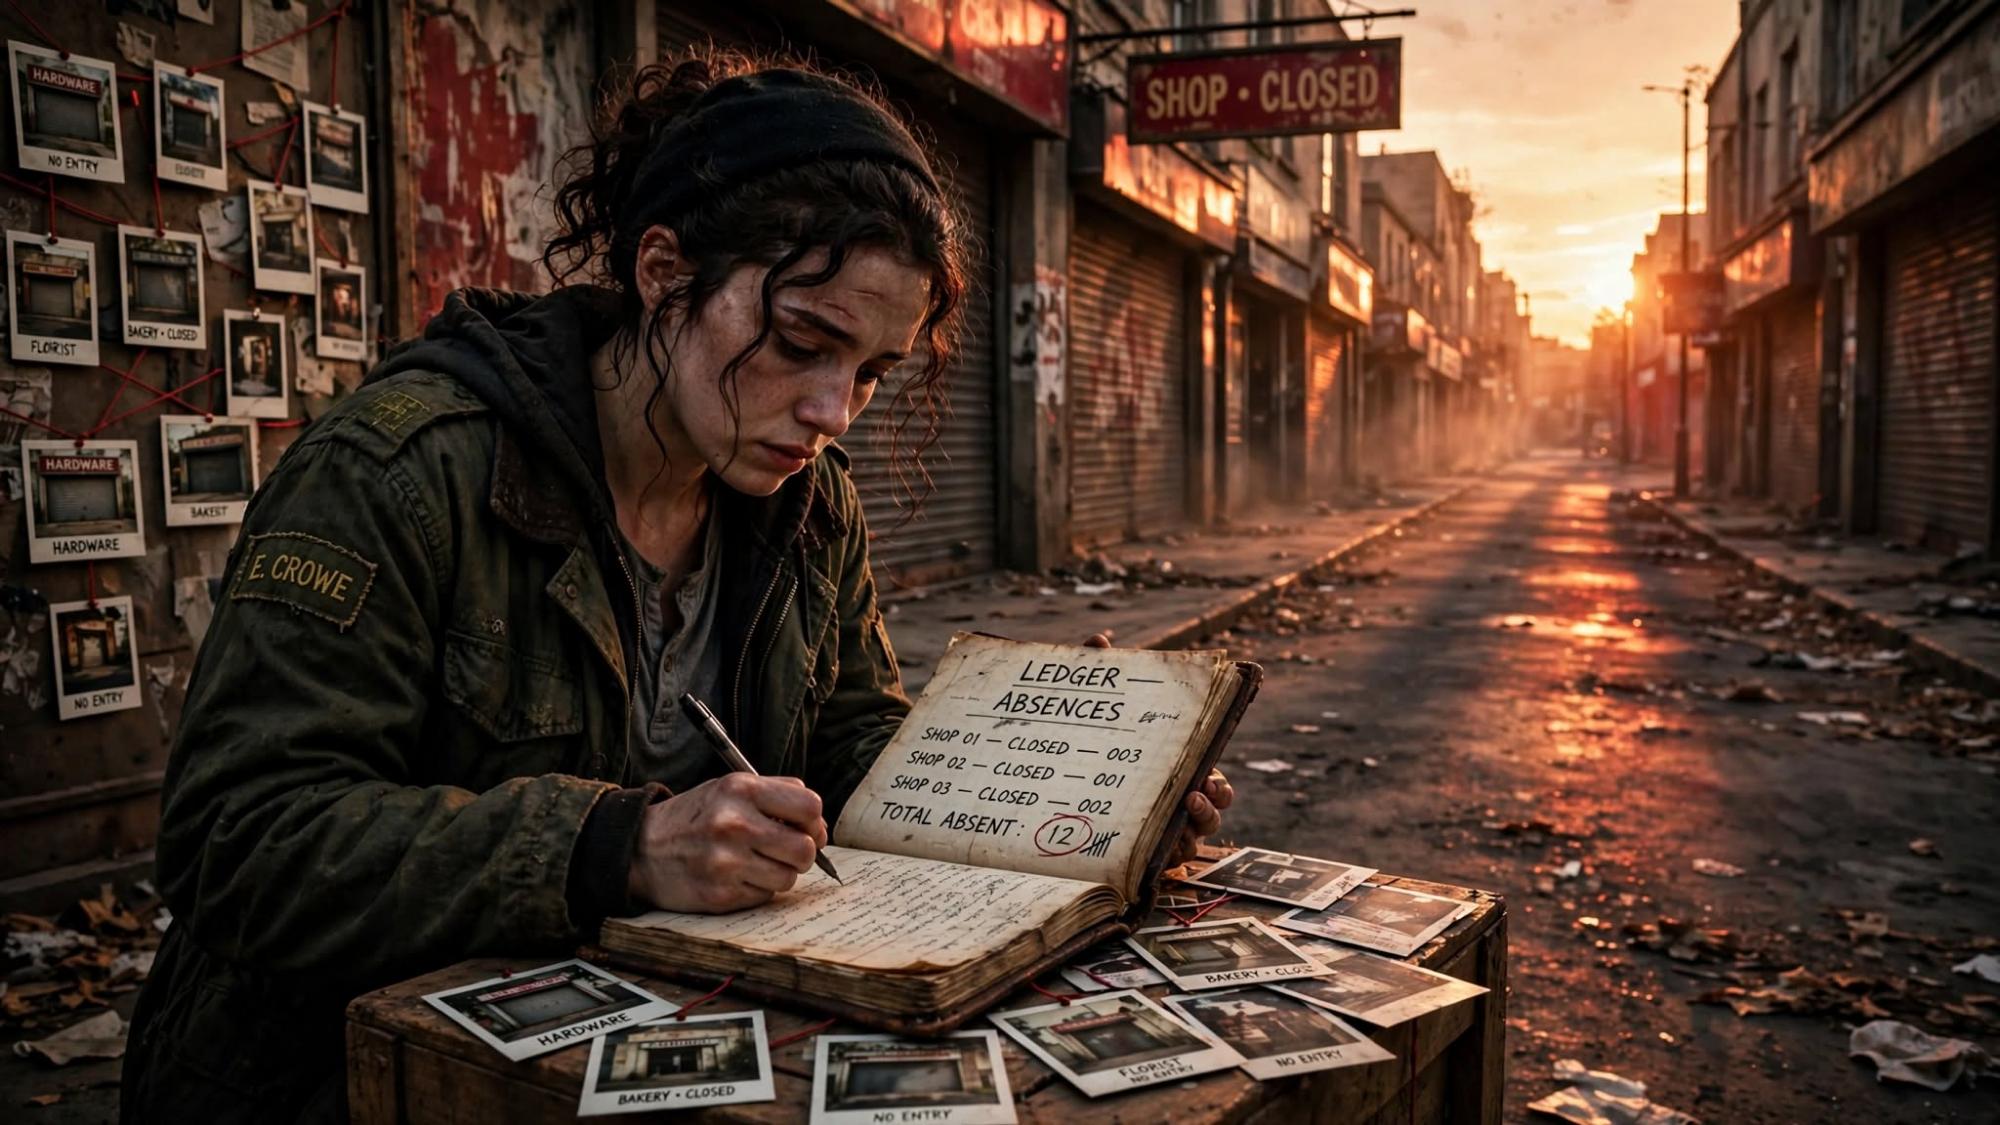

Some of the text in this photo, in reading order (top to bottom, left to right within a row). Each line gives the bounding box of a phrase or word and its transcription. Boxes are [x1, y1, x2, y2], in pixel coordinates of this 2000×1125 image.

[33, 68, 97, 93] HARDWARE
[1147, 75, 1228, 120] SHOP
[1260, 65, 1379, 113] CLOSED
[48, 154, 98, 173] NO ENTRY
[128, 325, 158, 340] BAKERY
[167, 328, 197, 341] CLOSED
[46, 458, 115, 471] HARDWARE
[53, 538, 120, 555] HARDWARE
[248, 554, 353, 602] E. CROWE
[1019, 660, 1120, 688] LEDGER
[74, 691, 124, 710] NO ENTRY
[993, 691, 1125, 722] ABSENCES
[921, 727, 960, 743] SHOP
[963, 732, 981, 746] 01
[1007, 736, 1070, 755] CLOSED
[1106, 748, 1142, 763] 003
[907, 751, 945, 766] SHOP
[947, 756, 967, 770] 02
[993, 762, 1055, 780] CLOSED
[1093, 773, 1126, 789] 001
[891, 775, 929, 791] SHOP
[932, 781, 952, 795] 03
[978, 786, 1039, 806] CLOSED
[1077, 799, 1113, 815] 002
[880, 802, 932, 825] TOTAL
[1047, 825, 1074, 846] 12
[1205, 970, 1260, 983] BAKERY
[537, 1012, 632, 1046] HARDWARE
[1118, 1057, 1182, 1077] FLORIST
[1276, 1049, 1343, 1068] NO ENTRY
[618, 1090, 671, 1105] BAKERY
[685, 1085, 735, 1100] CLOSED
[873, 1109, 952, 1122] NO ENTRY
